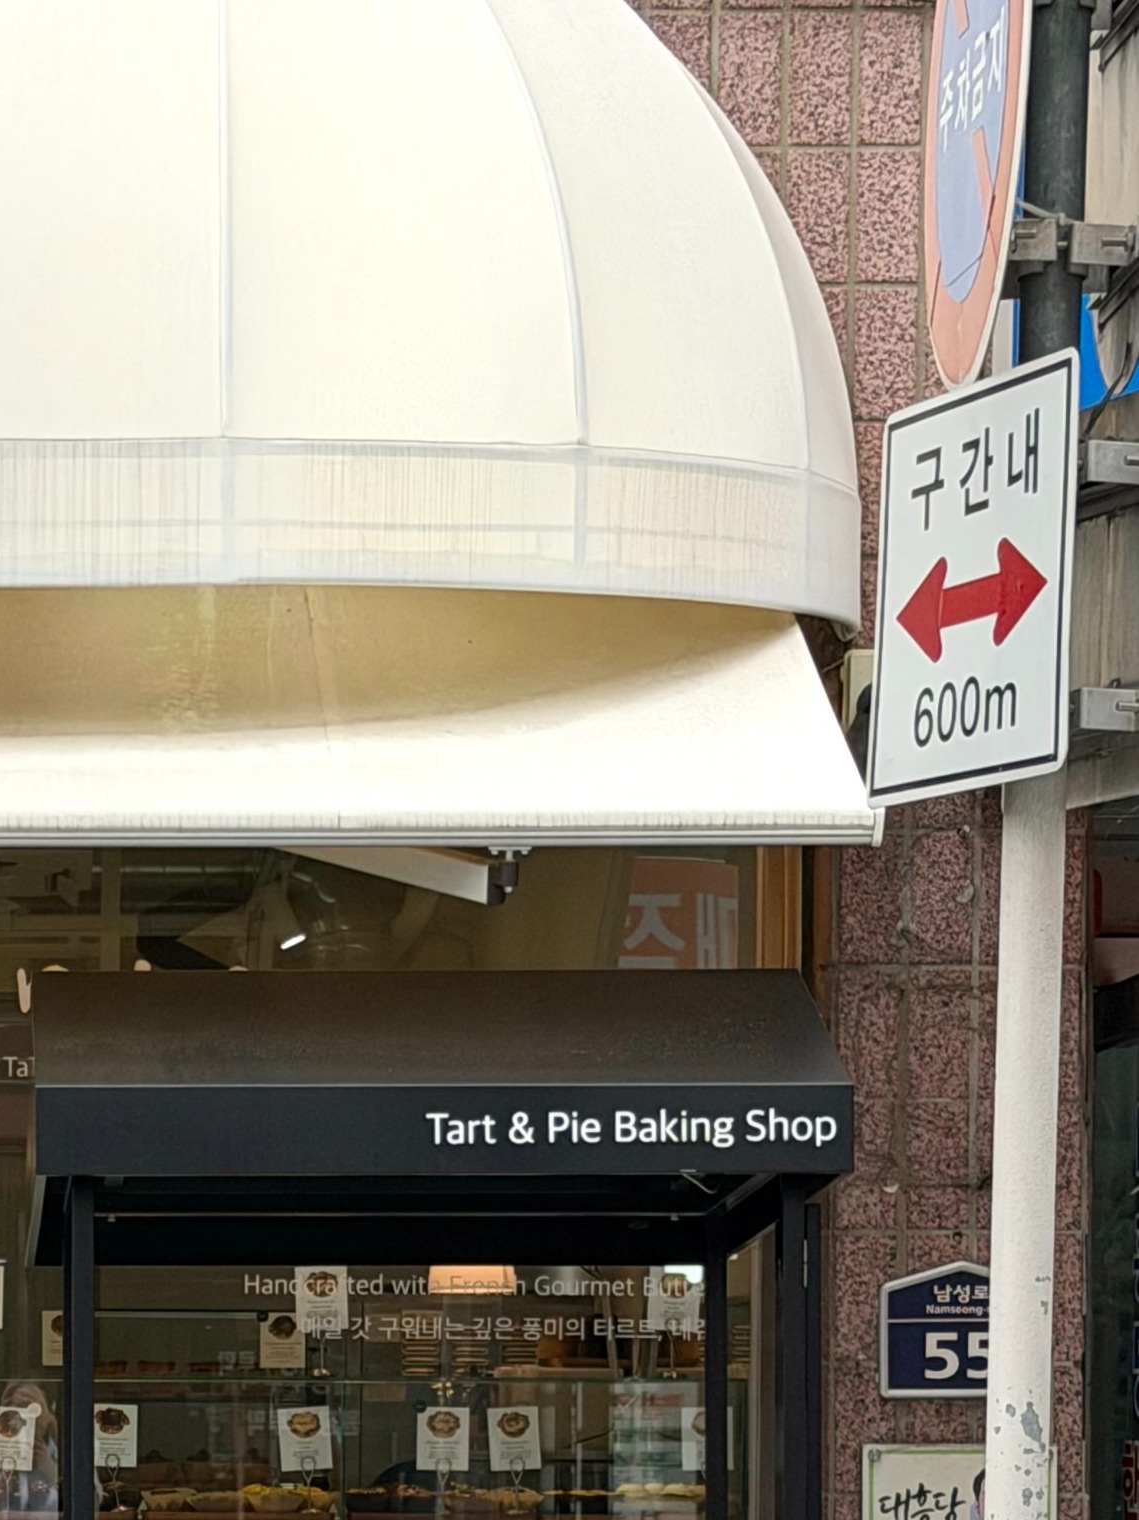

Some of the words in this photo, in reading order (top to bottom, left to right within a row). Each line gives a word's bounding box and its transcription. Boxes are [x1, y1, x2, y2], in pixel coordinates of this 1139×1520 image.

[939, 5, 1005, 152] 주차금지
[911, 408, 1041, 531] 구간내
[913, 676, 1017, 748] 600m
[2, 1056, 34, 1077] Ta
[426, 1112, 496, 1145] Tart
[508, 1113, 536, 1145] &
[547, 1110, 602, 1144] Pie
[614, 1109, 735, 1149] Baking
[745, 1108, 838, 1147] Shop
[244, 1273, 384, 1296] Handcrafted
[534, 1274, 635, 1297] Gourmet
[644, 1275, 705, 1297] Butte
[933, 1284, 989, 1303] 남성로
[300, 1315, 344, 1341] 매일
[350, 1315, 372, 1341] 갓
[521, 1315, 585, 1341] 풍미의
